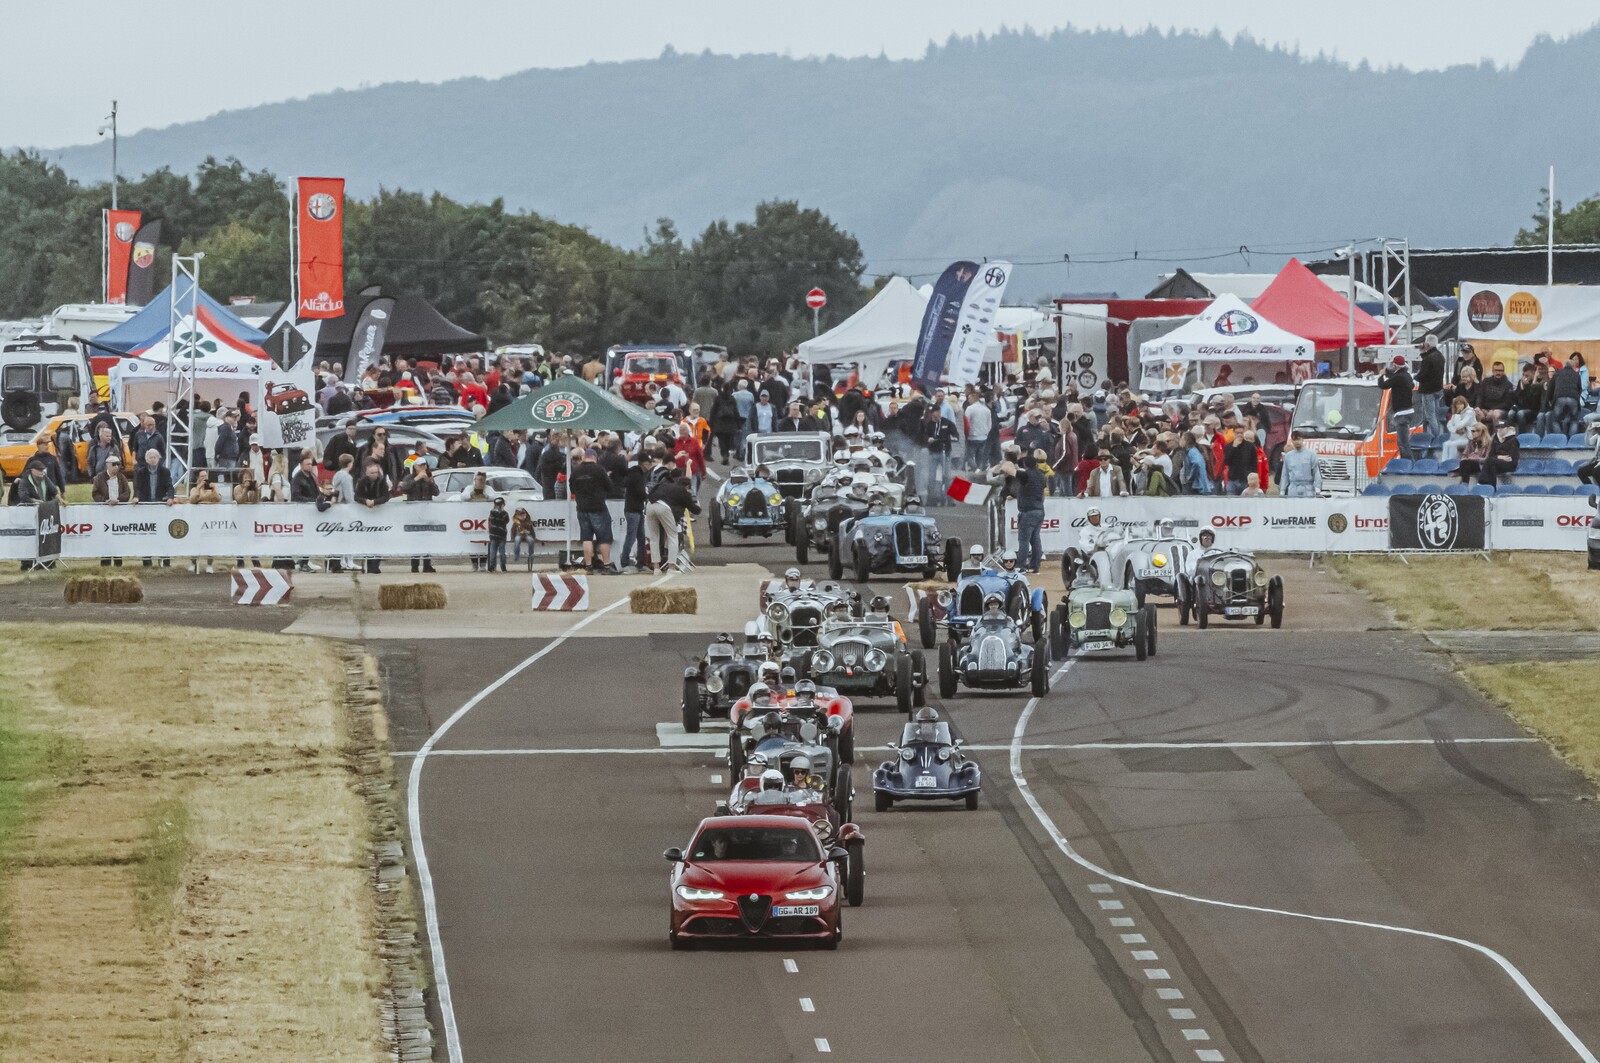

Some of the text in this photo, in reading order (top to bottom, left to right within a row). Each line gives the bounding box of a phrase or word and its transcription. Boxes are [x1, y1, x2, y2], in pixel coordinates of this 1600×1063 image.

[1303, 441, 1356, 455] UERWEHR
[1420, 495, 1456, 529] ALFA ROMEO
[201, 520, 238, 530] APPIA
[460, 518, 491, 530] OK
[532, 519, 566, 527] eFRAME
[1010, 518, 1060, 528] bse
[1212, 516, 1252, 527] OKP
[1272, 516, 1316, 526] LiveFRAME
[1354, 515, 1389, 528] bros
[112, 523, 156, 532] LiveFRAME
[254, 521, 303, 533] brose
[316, 520, 392, 536] Alfa Romeo
